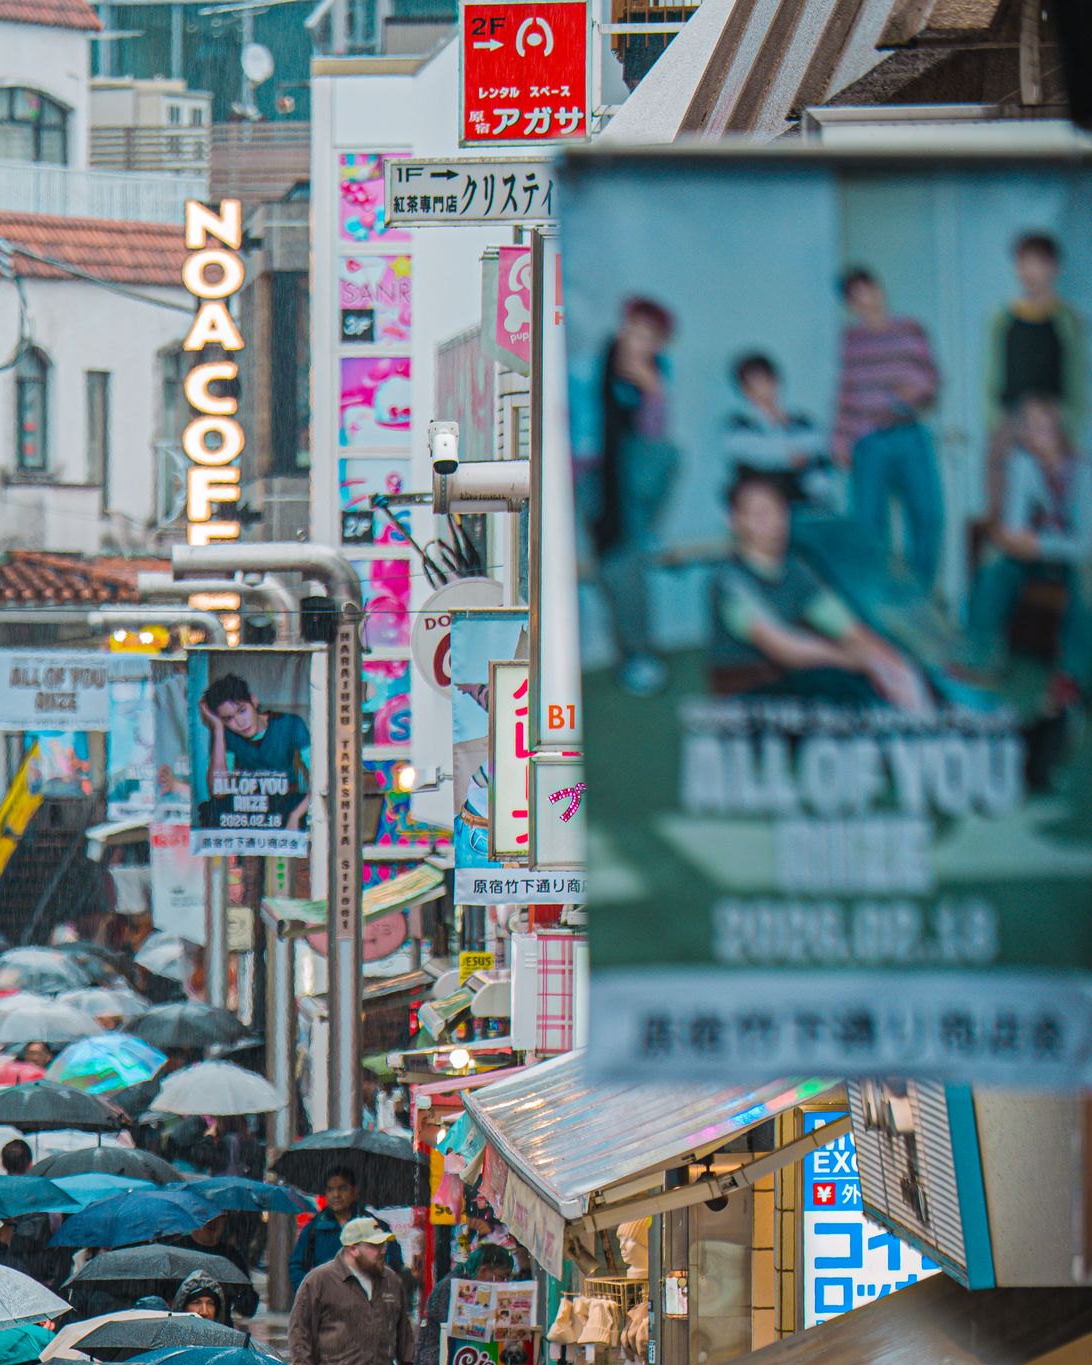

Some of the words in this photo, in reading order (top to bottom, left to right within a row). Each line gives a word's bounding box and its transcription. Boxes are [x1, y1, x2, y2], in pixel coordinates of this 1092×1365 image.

[471, 17, 506, 35] 2F
[478, 87, 520, 99] レンタル
[530, 86, 571, 98] スペース
[492, 106, 585, 135] アガサ
[396, 167, 425, 183] 1F
[393, 194, 458, 214] 紅茶専門店
[182, 198, 246, 352] NOA
[510, 332, 531, 345] pup
[548, 704, 576, 730] B1
[259, 777, 288, 796] YOU
[461, 956, 492, 967] JESUS
[814, 1222, 943, 1272] コイ
